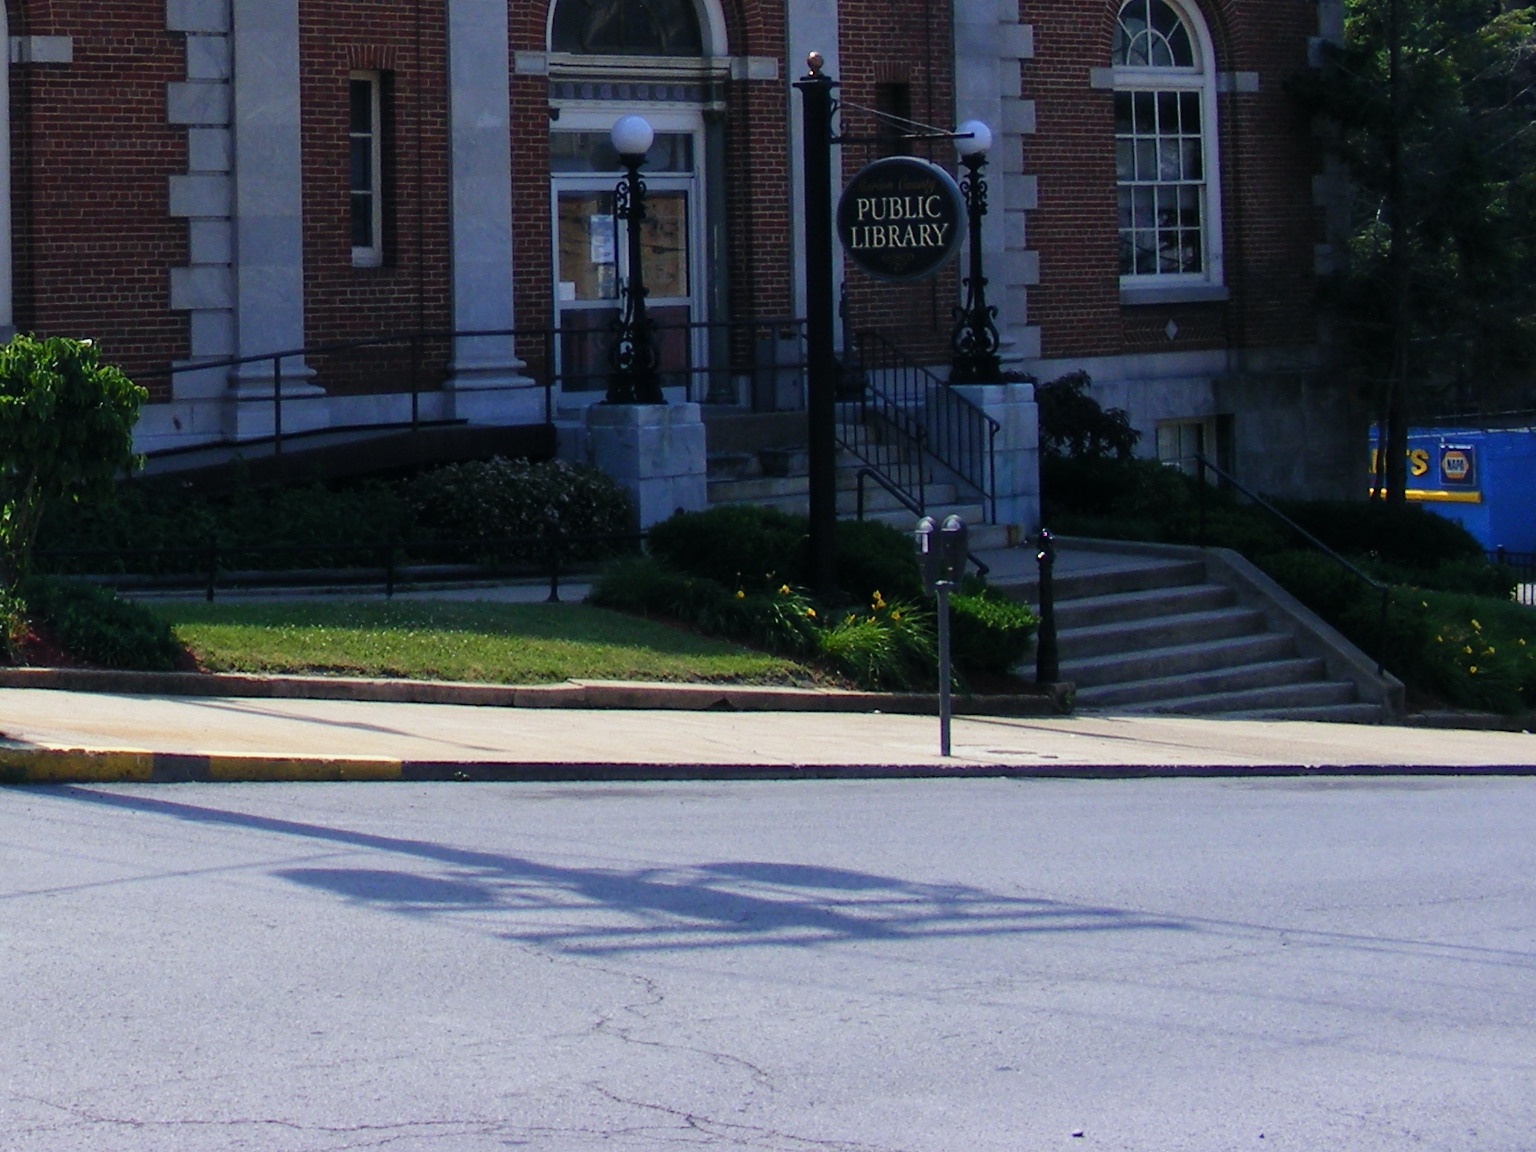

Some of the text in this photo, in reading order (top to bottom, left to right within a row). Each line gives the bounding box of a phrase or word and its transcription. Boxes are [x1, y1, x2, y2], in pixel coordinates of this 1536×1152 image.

[856, 195, 942, 221] PUBLIC
[850, 223, 949, 248] LIBRARY
[1446, 458, 1464, 471] NAPA
